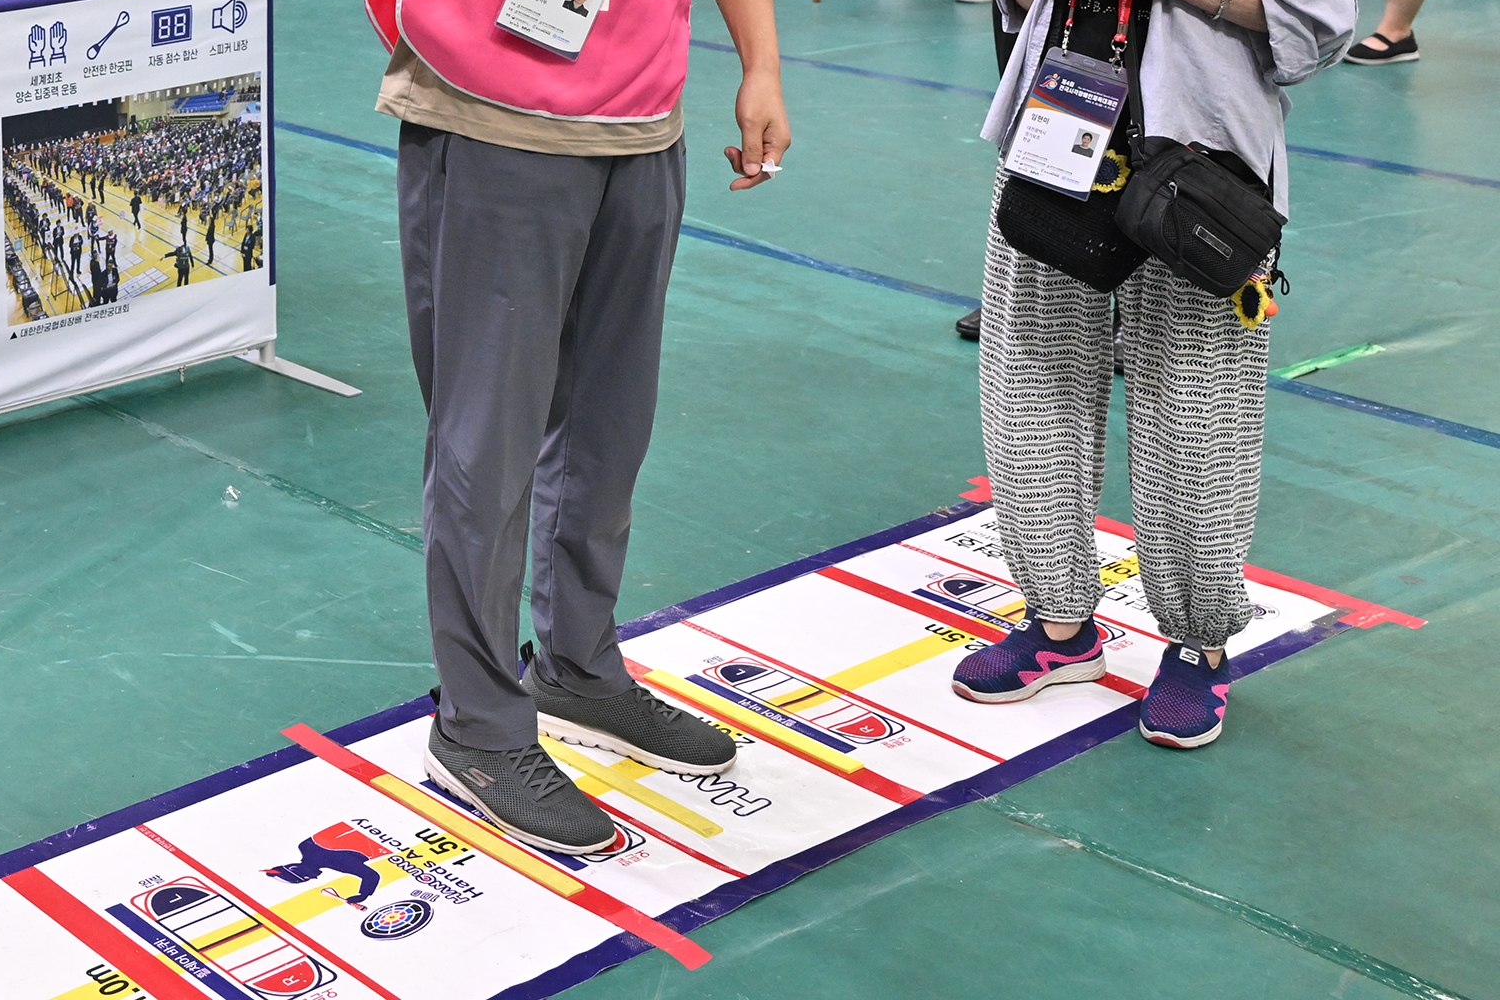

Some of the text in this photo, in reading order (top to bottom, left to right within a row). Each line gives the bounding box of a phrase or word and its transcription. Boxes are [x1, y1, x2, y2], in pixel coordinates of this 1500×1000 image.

[158, 13, 187, 38] 88
[148, 48, 198, 68] 자동 점수 합산
[209, 39, 248, 57] 스피커 내장
[29, 70, 63, 88] 세계최초
[83, 59, 133, 79] 안전한 한궁핀
[15, 83, 78, 104] 양손 집중력 운동
[1031, 113, 1050, 124] 임현미
[20, 303, 130, 338] 대한한궁협회장배 전국한궁대회
[924, 623, 989, 651] 2.5m
[738, 698, 797, 728] 휠체어 바퀴
[860, 725, 874, 733] R
[351, 817, 424, 860] Archery
[415, 827, 476, 866] 1.5m
[615, 849, 650, 867] 오른발
[139, 874, 165, 889] 왼발
[388, 855, 470, 905] HANGUNG
[424, 860, 484, 899] Hands
[170, 894, 182, 903] L
[173, 951, 212, 979] 휠체어
[283, 975, 299, 986] R
